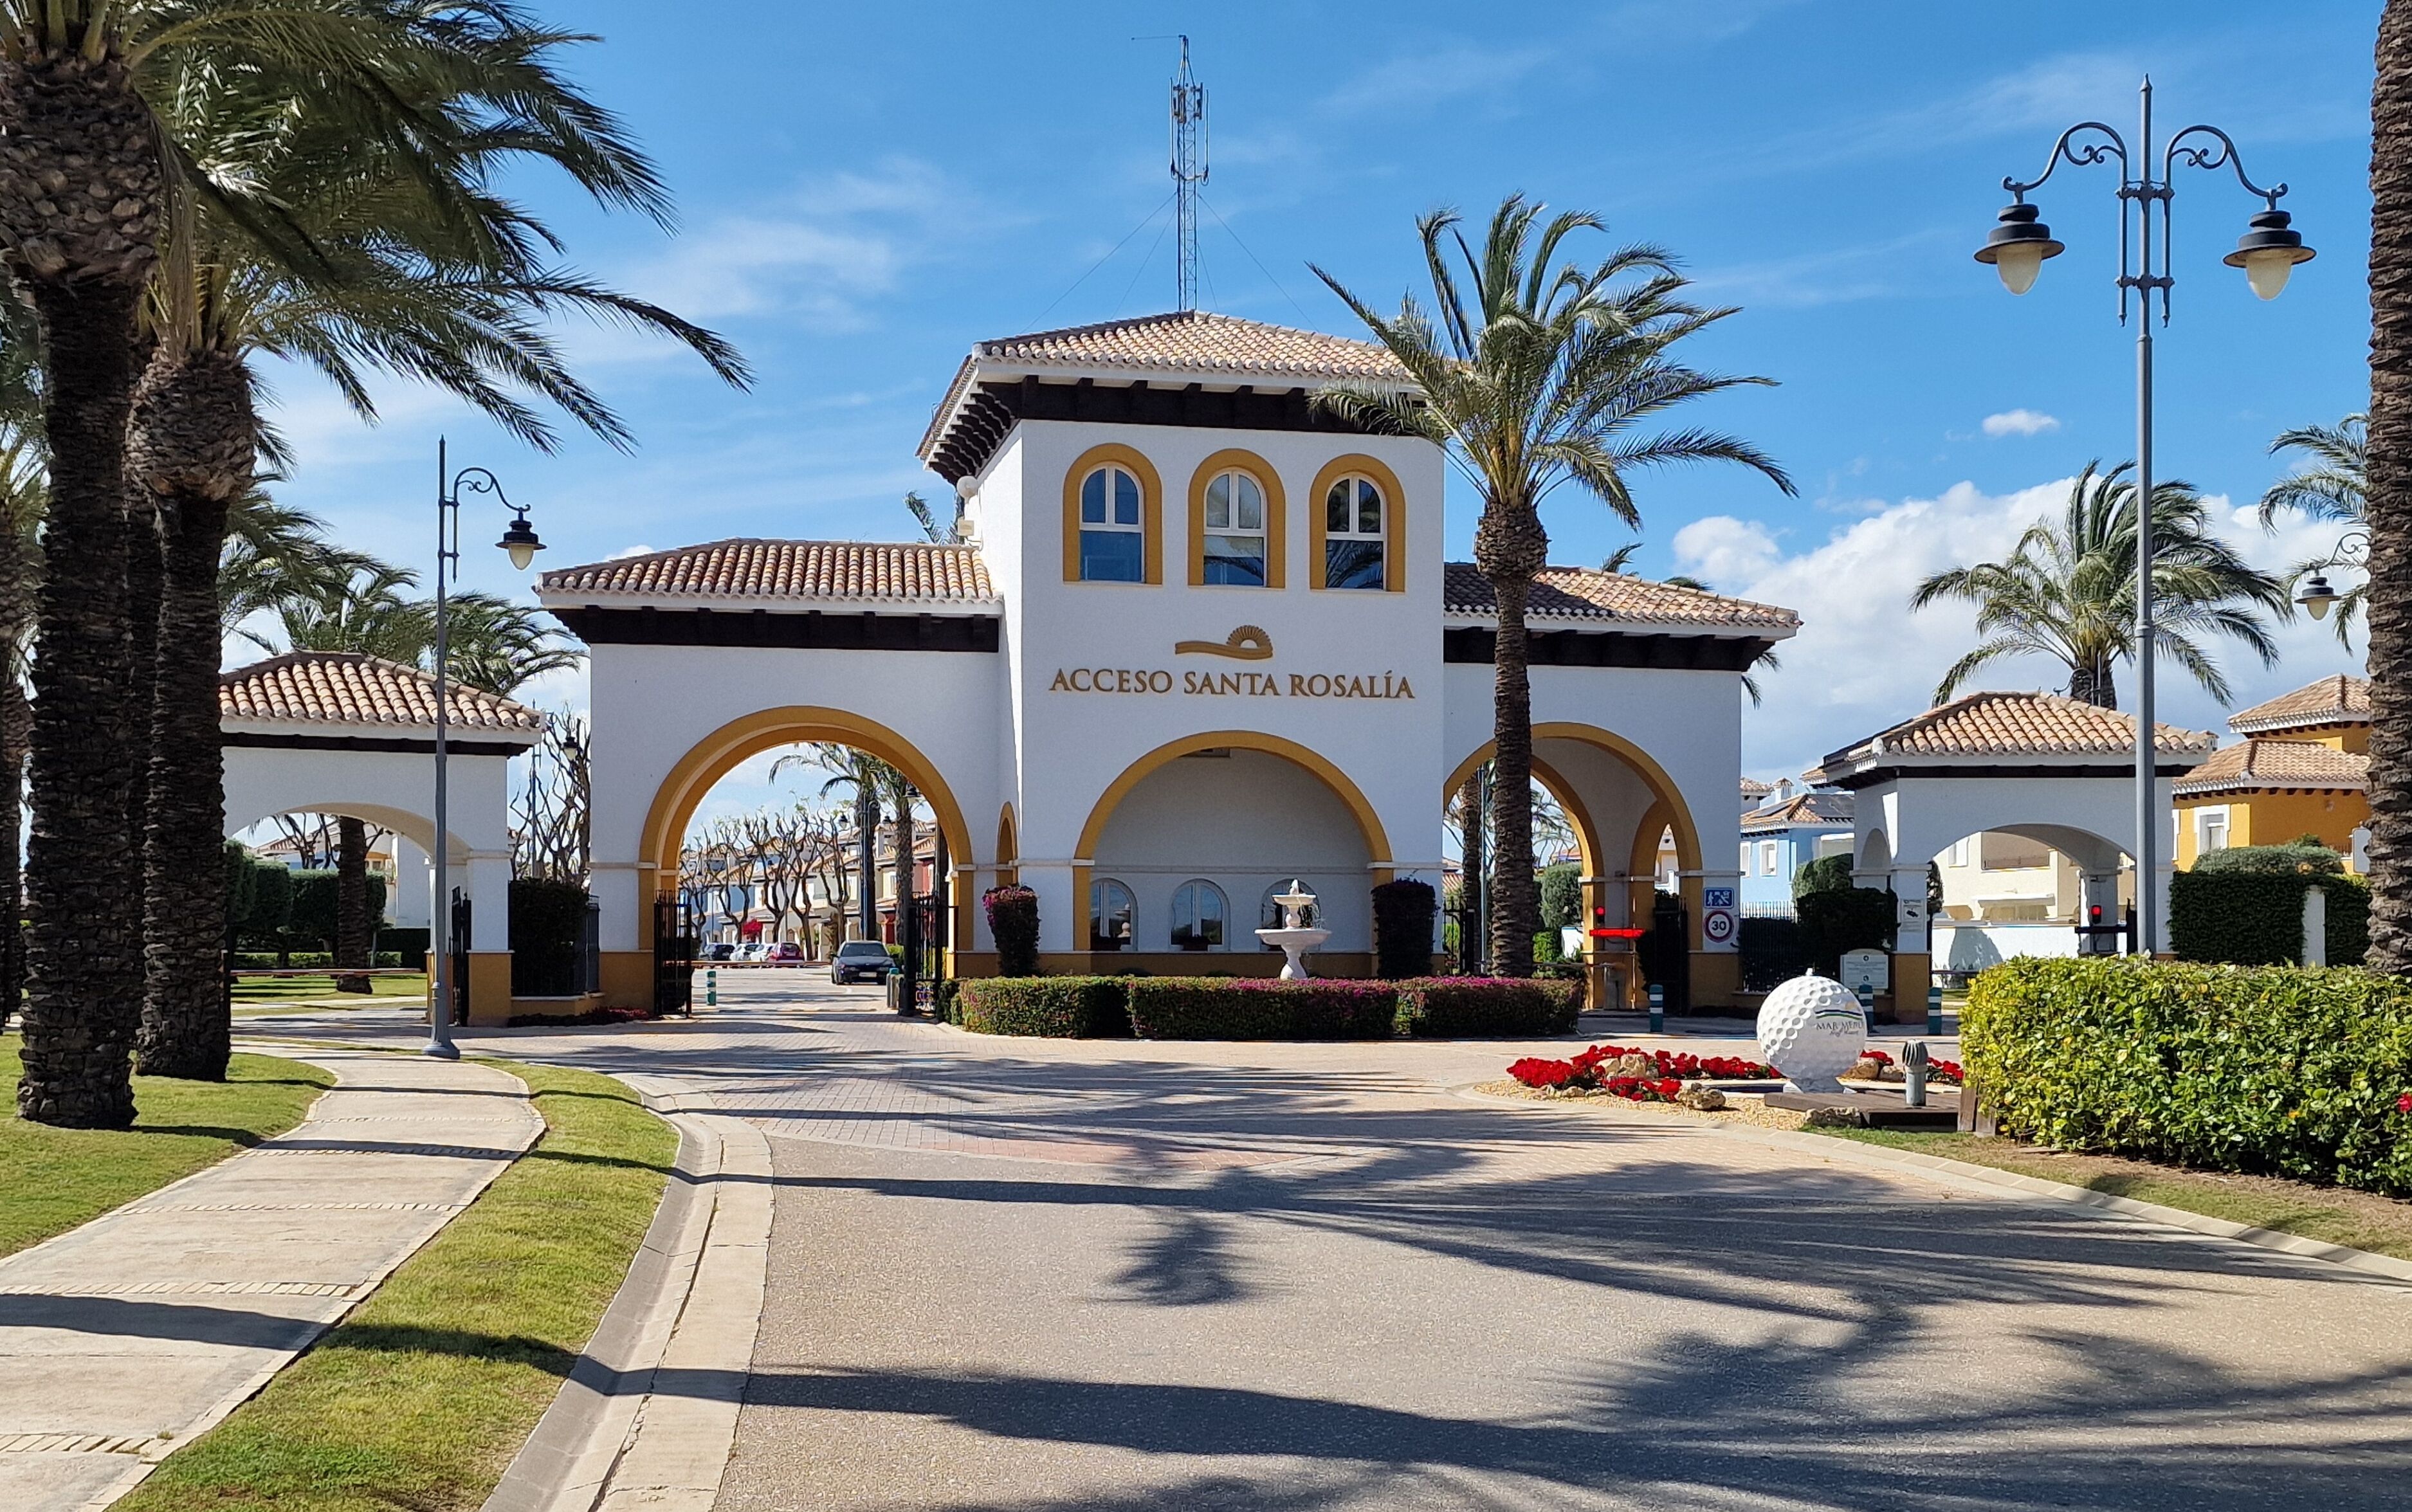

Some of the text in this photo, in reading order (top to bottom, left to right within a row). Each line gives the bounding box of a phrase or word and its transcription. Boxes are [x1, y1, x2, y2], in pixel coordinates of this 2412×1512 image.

[1049, 668, 1416, 698] ACCESO SANTA ROSALÍA
[1712, 920, 1727, 931] 30
[1816, 1021, 1838, 1030] MAR
